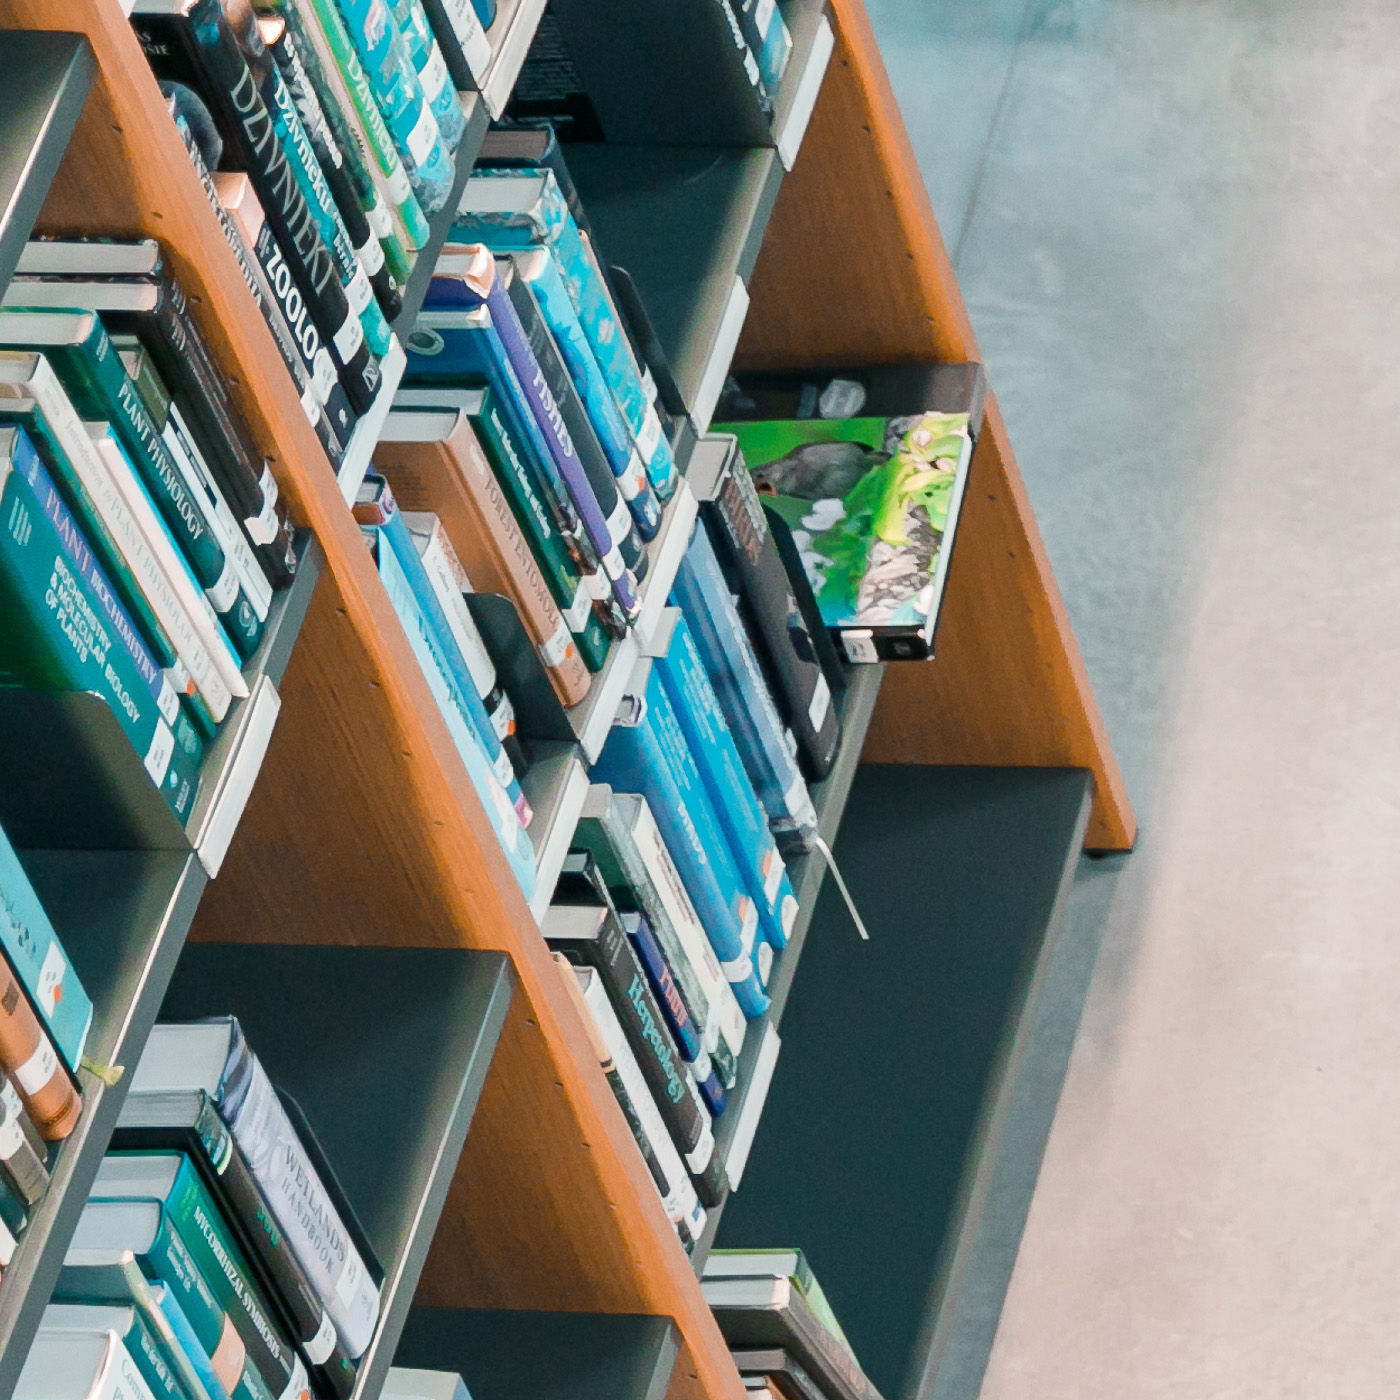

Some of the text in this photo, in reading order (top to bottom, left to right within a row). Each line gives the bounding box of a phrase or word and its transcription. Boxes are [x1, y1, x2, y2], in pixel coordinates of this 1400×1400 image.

[117, 379, 203, 547] PLANT PHYSIOLOGY
[484, 471, 516, 543] FOREST
[44, 485, 157, 688] PLANT BIOCHEMISTRY
[44, 584, 88, 667] OF PLANTS
[53, 552, 111, 656] BIOCHEMISTRY
[56, 579, 106, 670] MOLECULAR
[103, 661, 140, 728] BIOLOGY
[627, 975, 685, 1103] Herpetology
[280, 1173, 334, 1275] HANDBOOK
[285, 1145, 347, 1264] WETLANDS
[192, 1203, 245, 1300] MYCORRHIZAL
[241, 1289, 281, 1362] SYMBIOSIS
